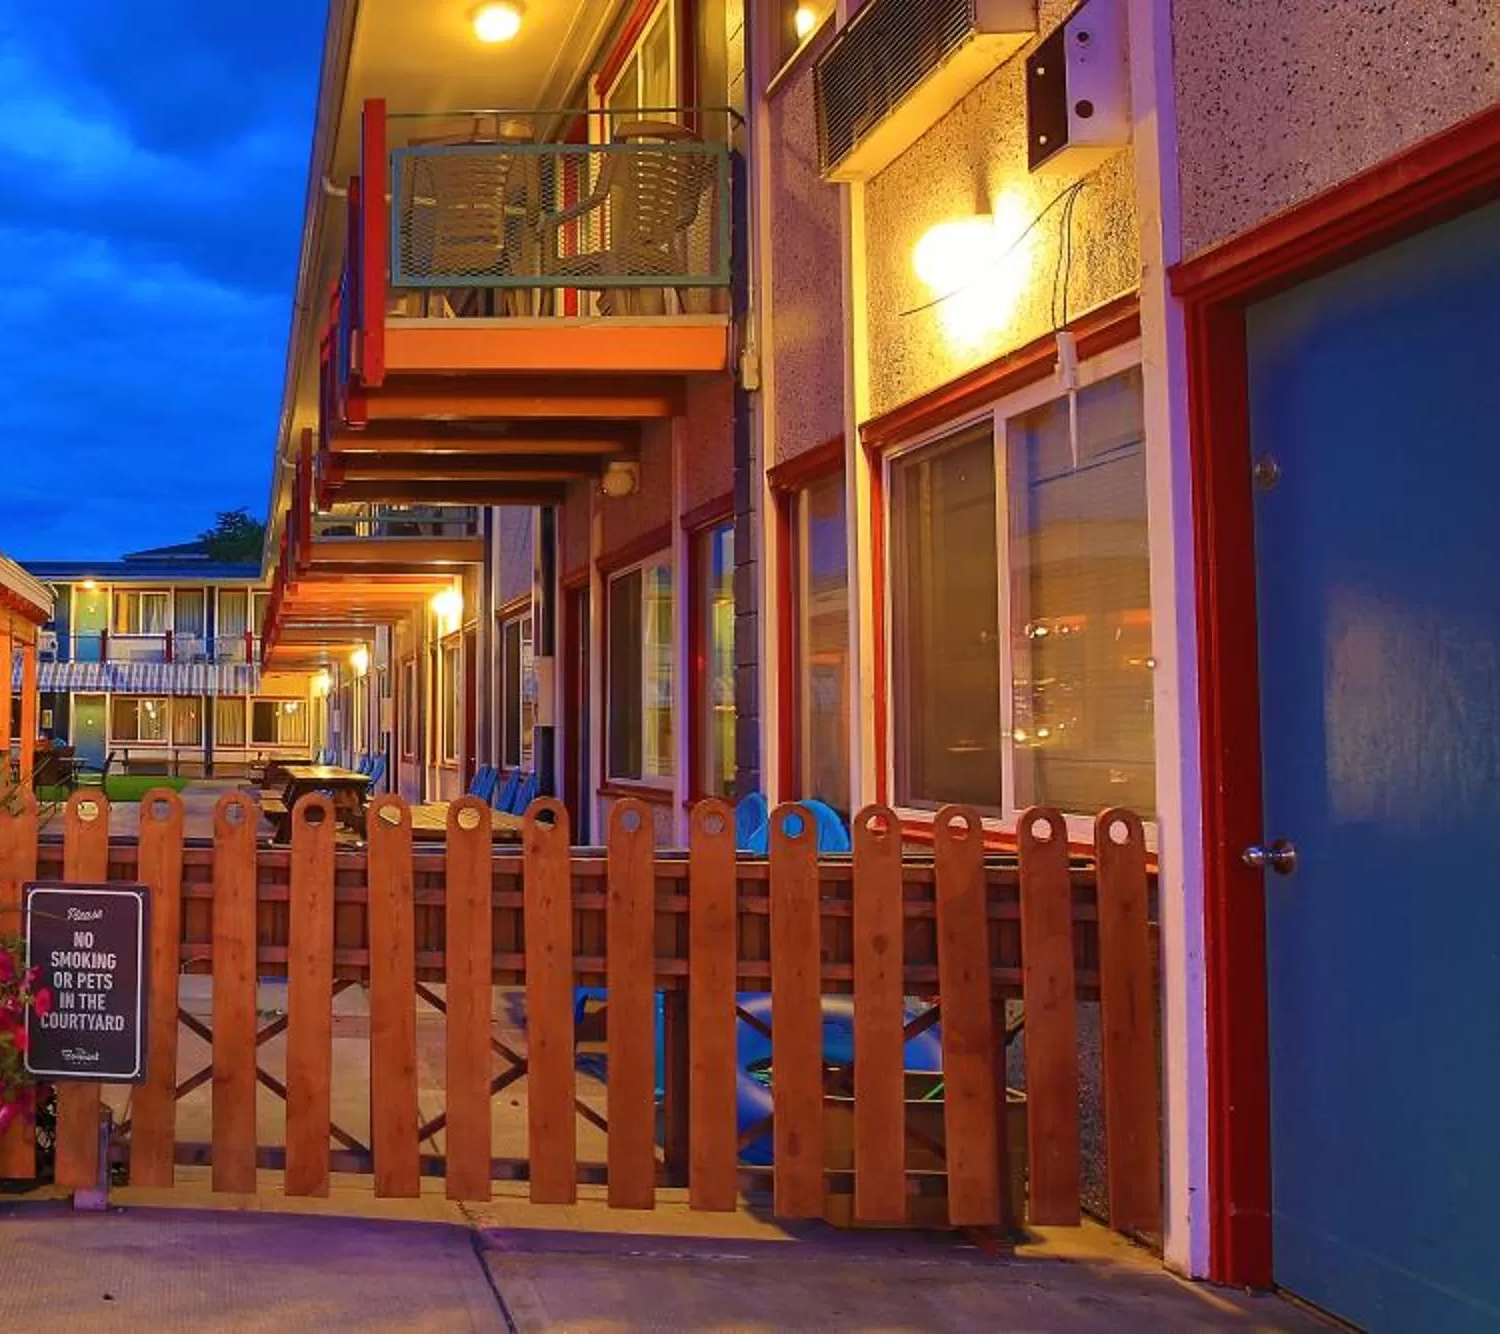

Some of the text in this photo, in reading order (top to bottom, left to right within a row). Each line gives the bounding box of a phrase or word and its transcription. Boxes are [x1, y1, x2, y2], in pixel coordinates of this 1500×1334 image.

[73, 931, 94, 948] NO
[51, 951, 116, 969] SMOKING
[53, 971, 113, 990] OR PETS
[60, 991, 107, 1010] IN THE
[41, 1012, 125, 1031] COURTYARD
